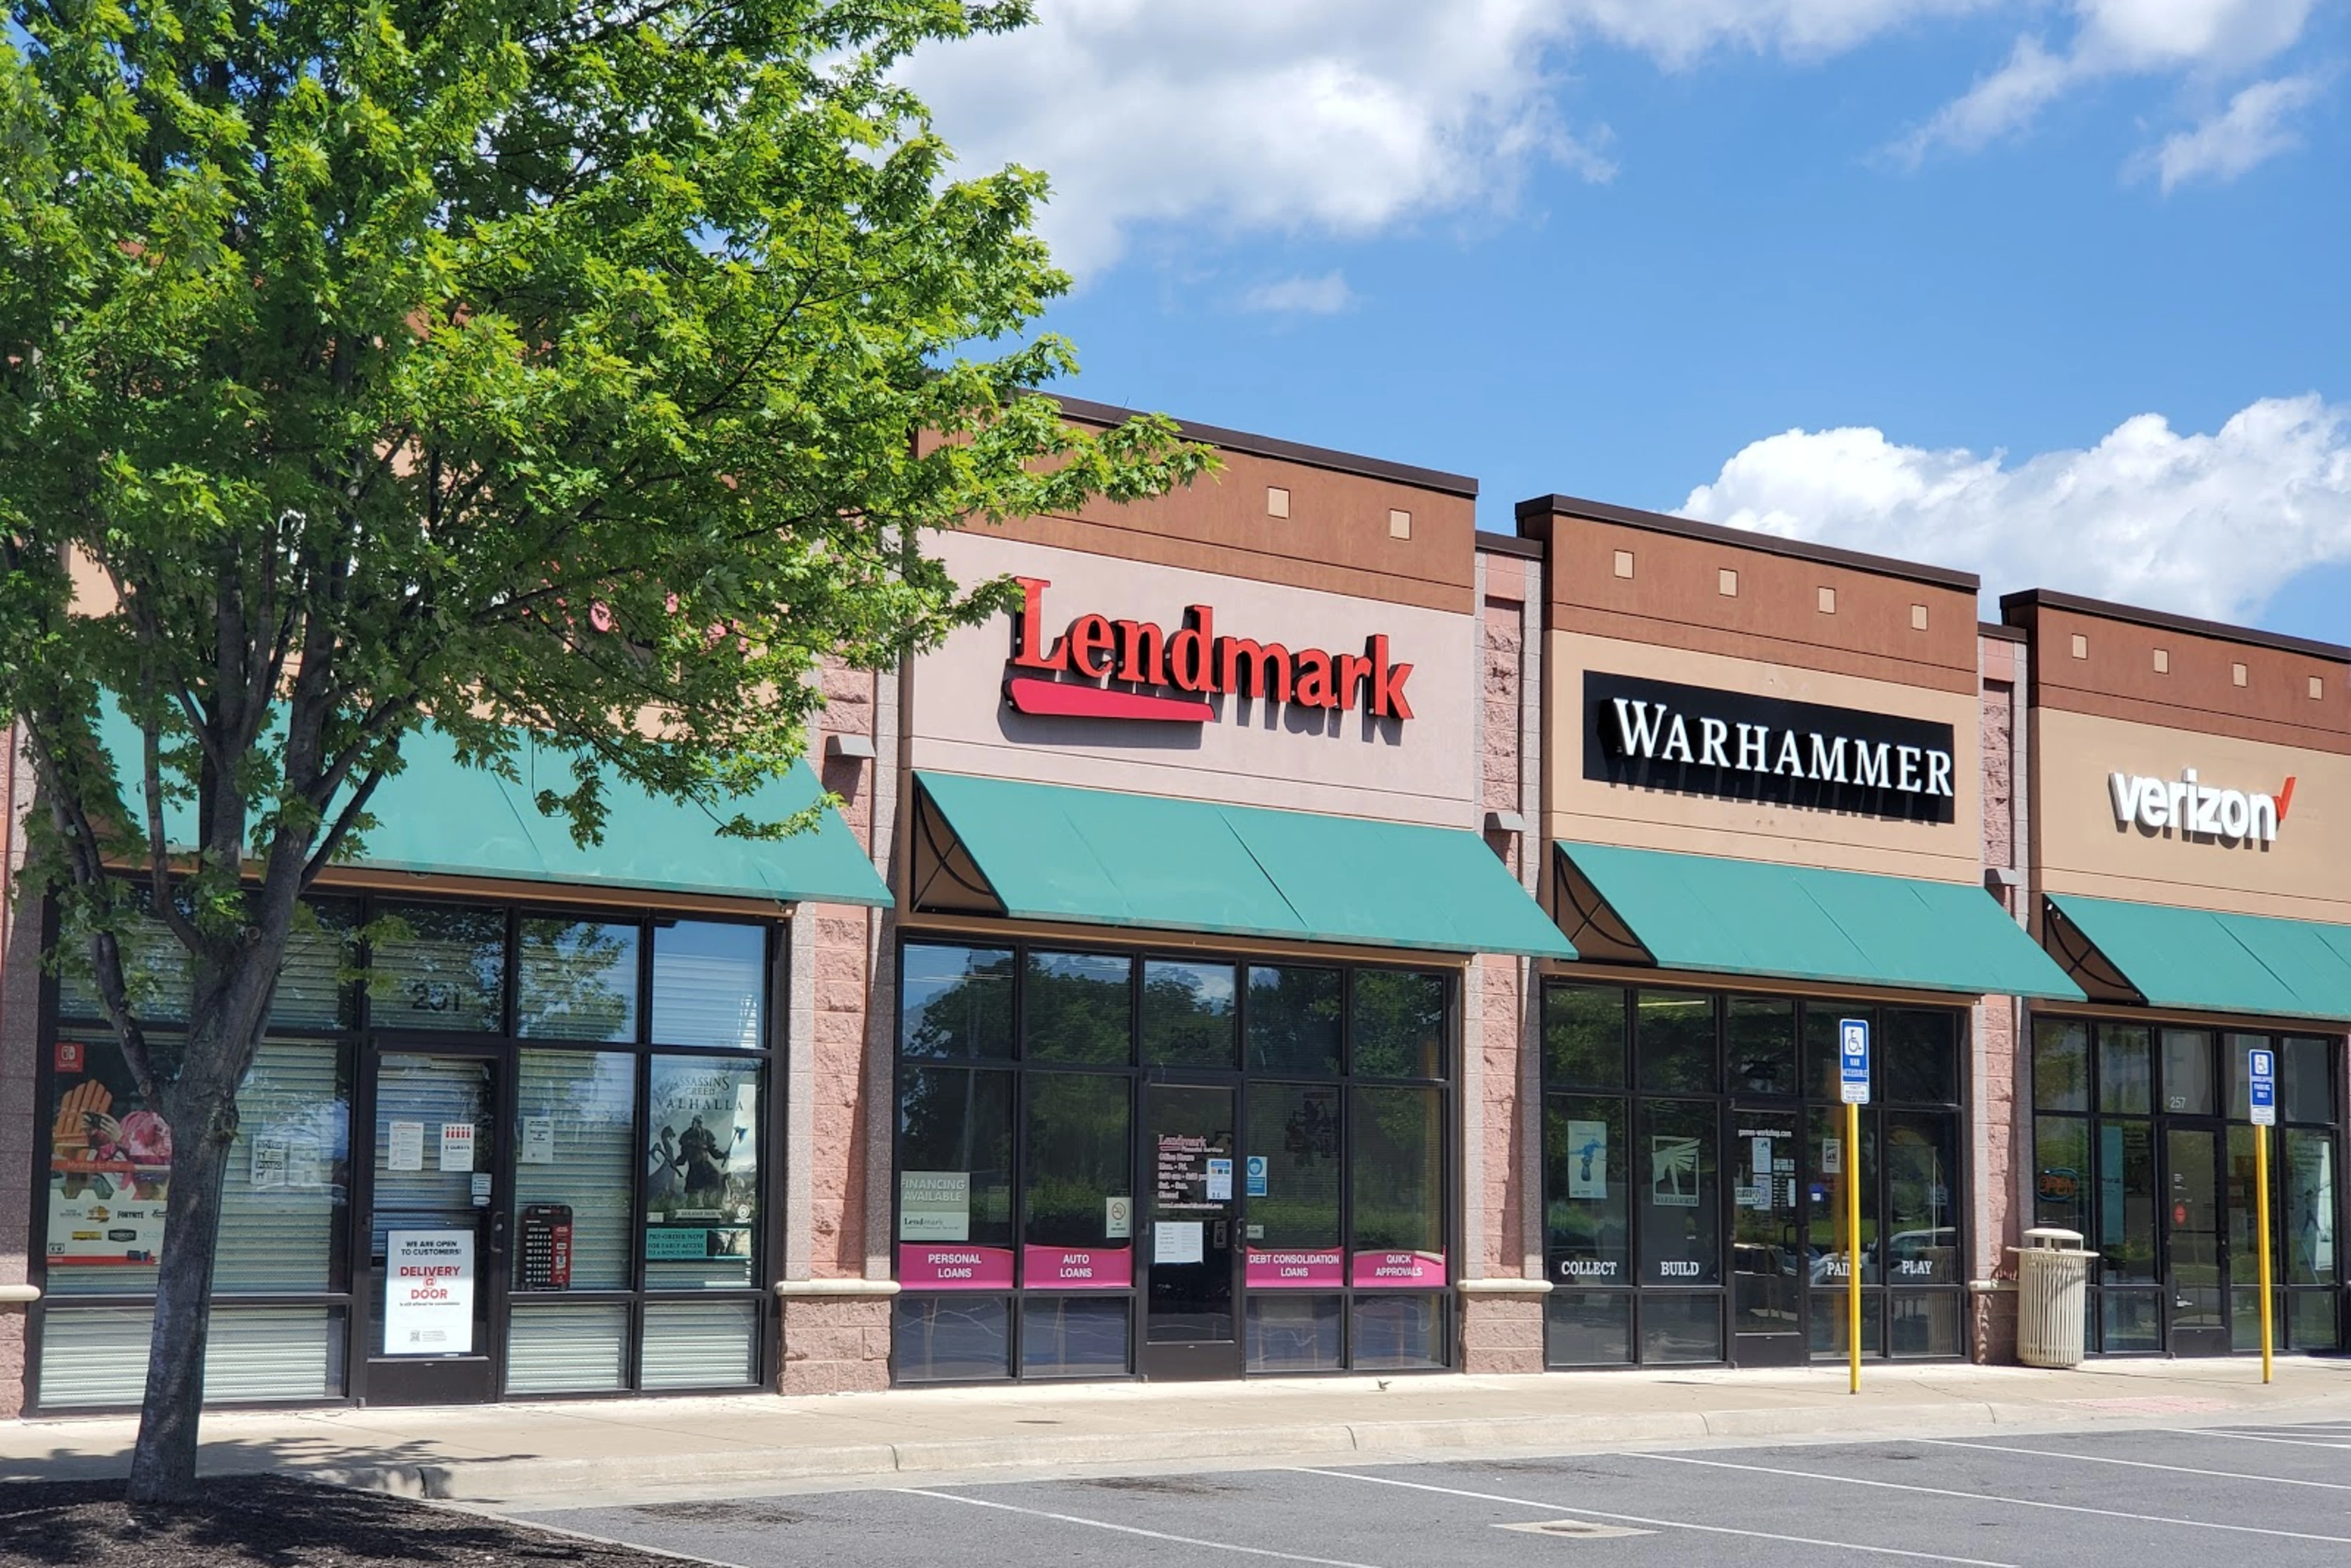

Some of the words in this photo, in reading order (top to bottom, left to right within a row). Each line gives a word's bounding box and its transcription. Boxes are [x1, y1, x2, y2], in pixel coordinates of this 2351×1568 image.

[1010, 576, 1415, 720] Lendmark
[1613, 697, 1954, 797] WARHAMMER
[2109, 767, 2277, 841] verizon
[685, 1087, 715, 1095] CREED
[656, 1098, 744, 1111] VALHALLA
[2169, 1095, 2186, 1109] 257
[1158, 1134, 1207, 1147] Lendmark
[901, 1179, 966, 1190] FINANCING
[904, 1191, 962, 1202] AVAILABLE
[928, 1253, 982, 1264] PERSONAL
[1062, 1254, 1090, 1264] AUTO
[1248, 1254, 1272, 1264] DEBT
[1273, 1254, 1340, 1264] CONSOLIDATION
[1386, 1255, 1412, 1264] QUICK
[400, 1266, 460, 1277] DELIVERY
[937, 1267, 972, 1278] LOANS
[1060, 1267, 1093, 1278] LOANS
[1280, 1267, 1309, 1277] LOANS
[1375, 1267, 1423, 1277] APPROVALS
[1561, 1260, 1618, 1275] COLLECT
[1660, 1261, 1700, 1276] BUILD
[1826, 1261, 1862, 1277] PAI
[1901, 1260, 1933, 1275] PLAY
[423, 1275, 437, 1288] @
[411, 1289, 448, 1299] DOOR
